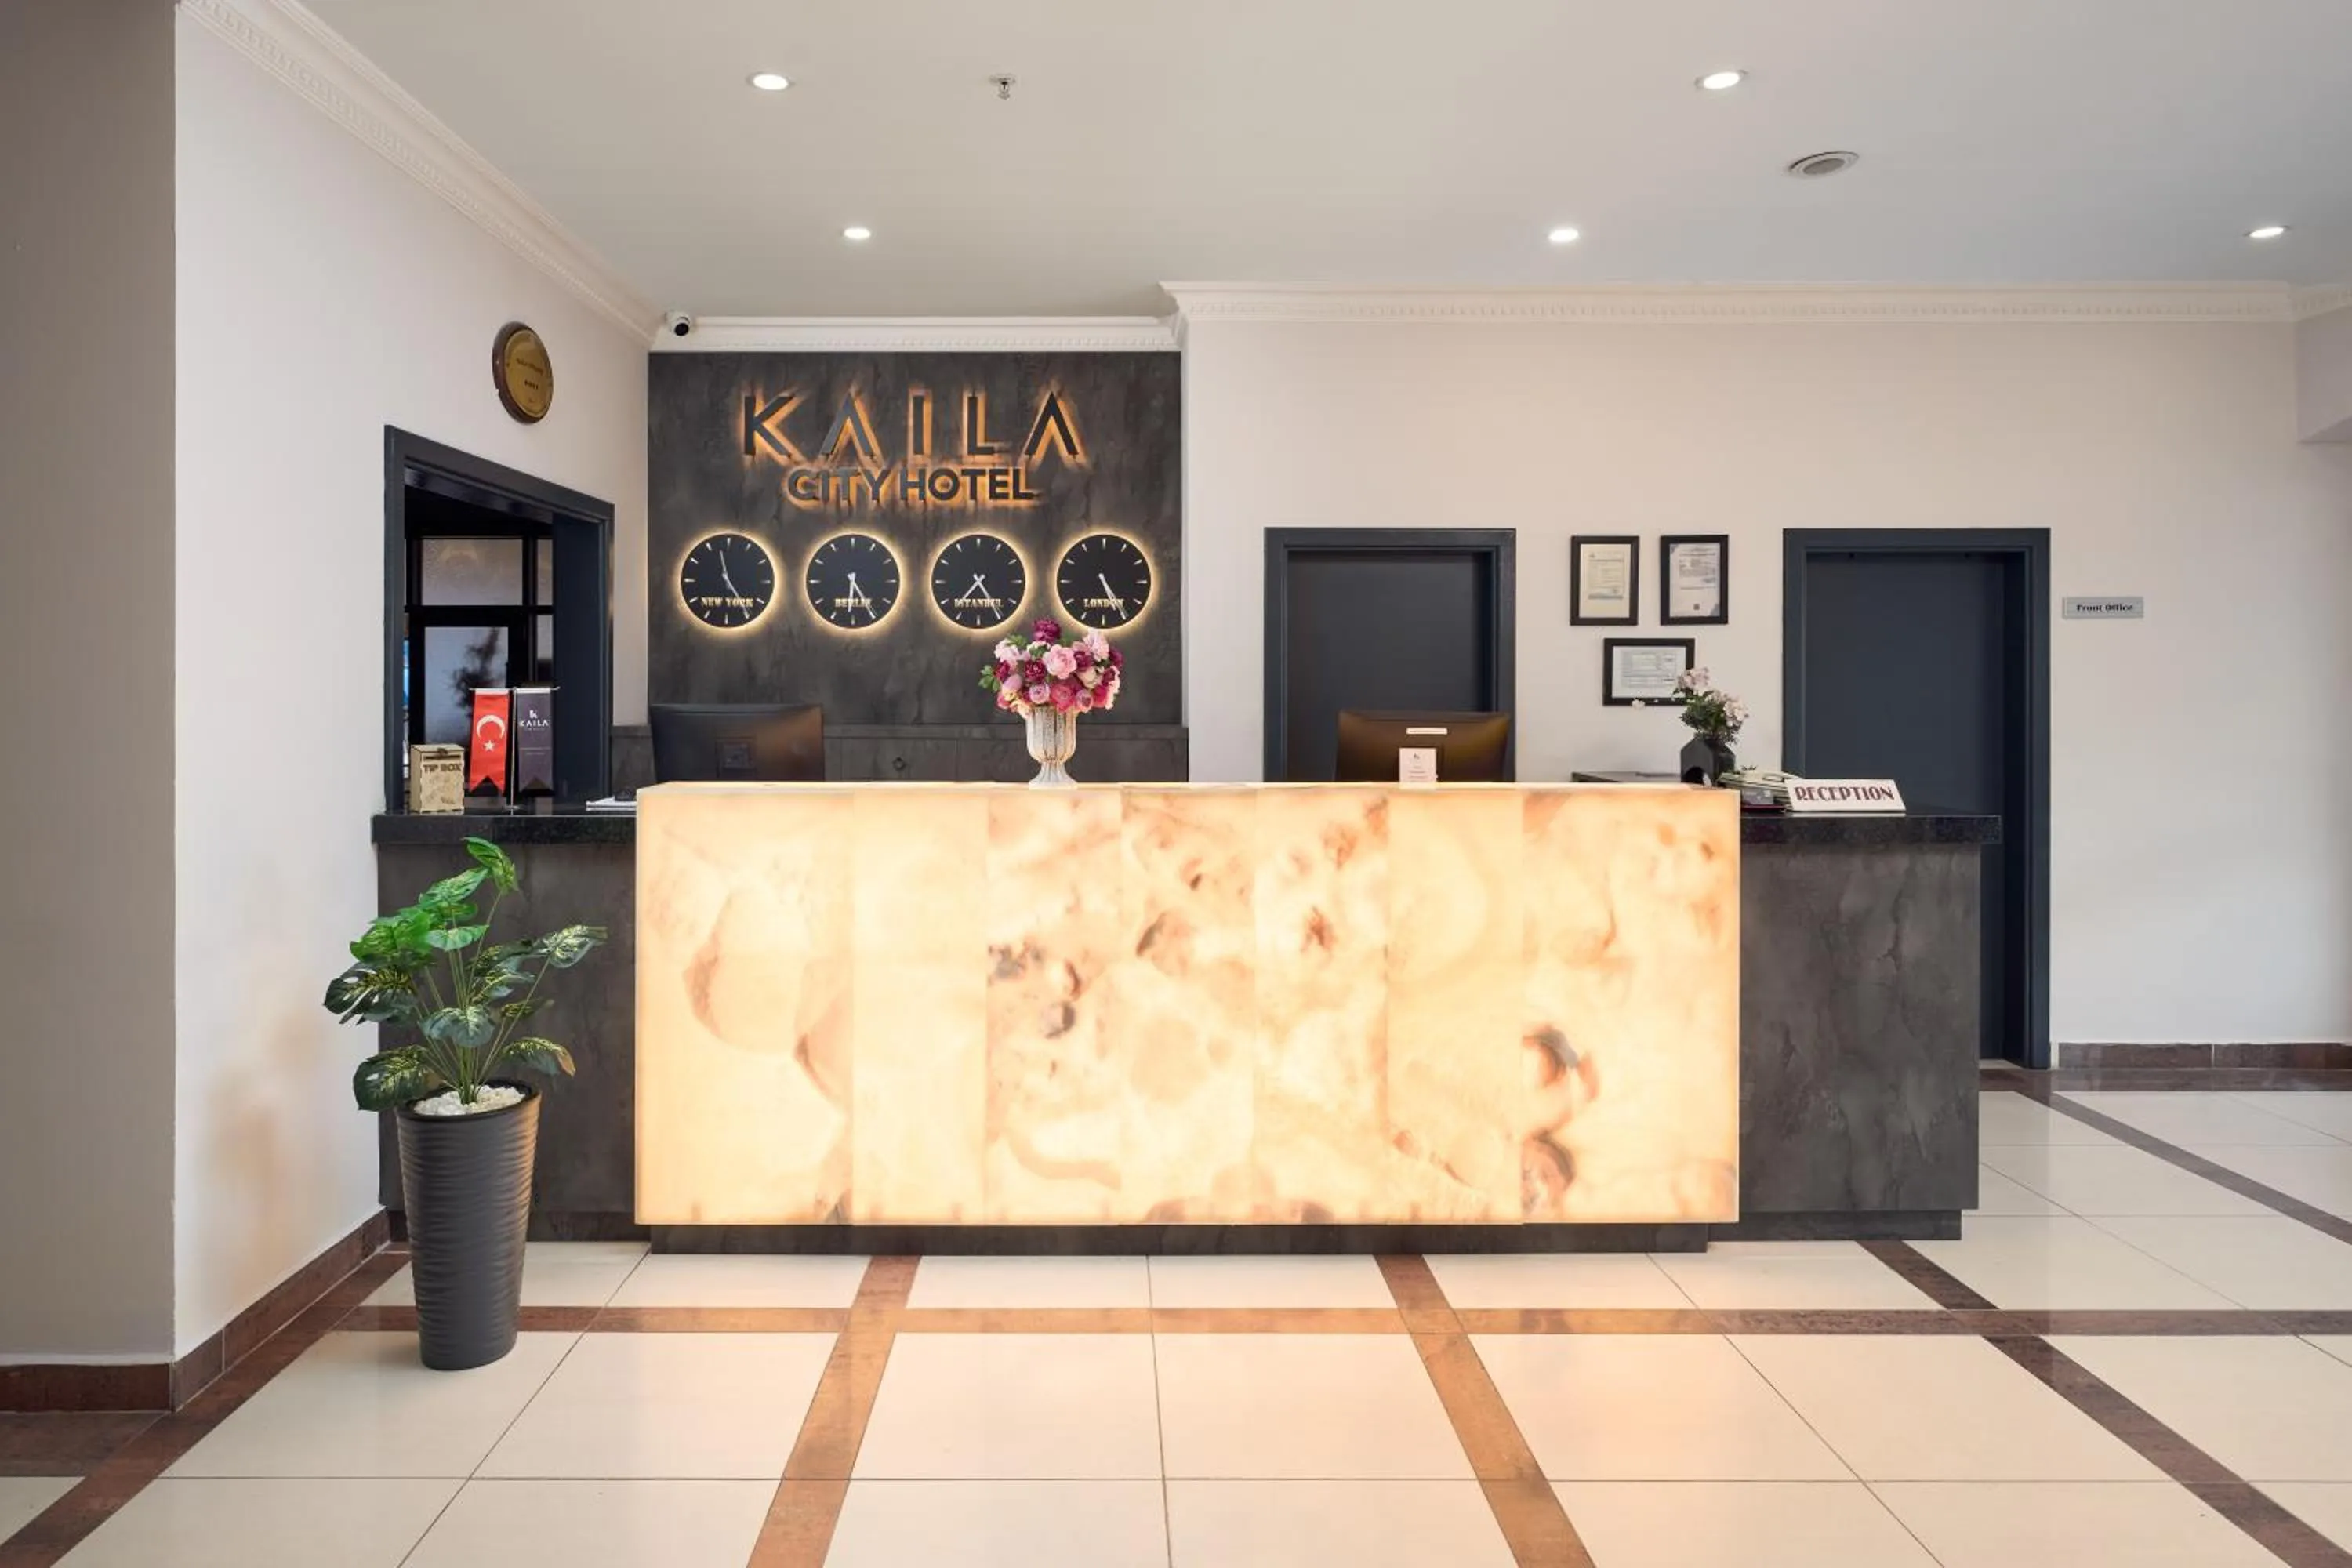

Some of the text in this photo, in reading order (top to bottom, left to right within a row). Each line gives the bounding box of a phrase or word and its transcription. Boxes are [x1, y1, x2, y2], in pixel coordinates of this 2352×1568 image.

[743, 390, 1080, 456] KAILA
[787, 466, 1036, 501] CITY HOTEL
[701, 597, 753, 607] NEW YORK
[423, 763, 461, 773] TIP BOX
[1795, 786, 1895, 800] RECEPTION
